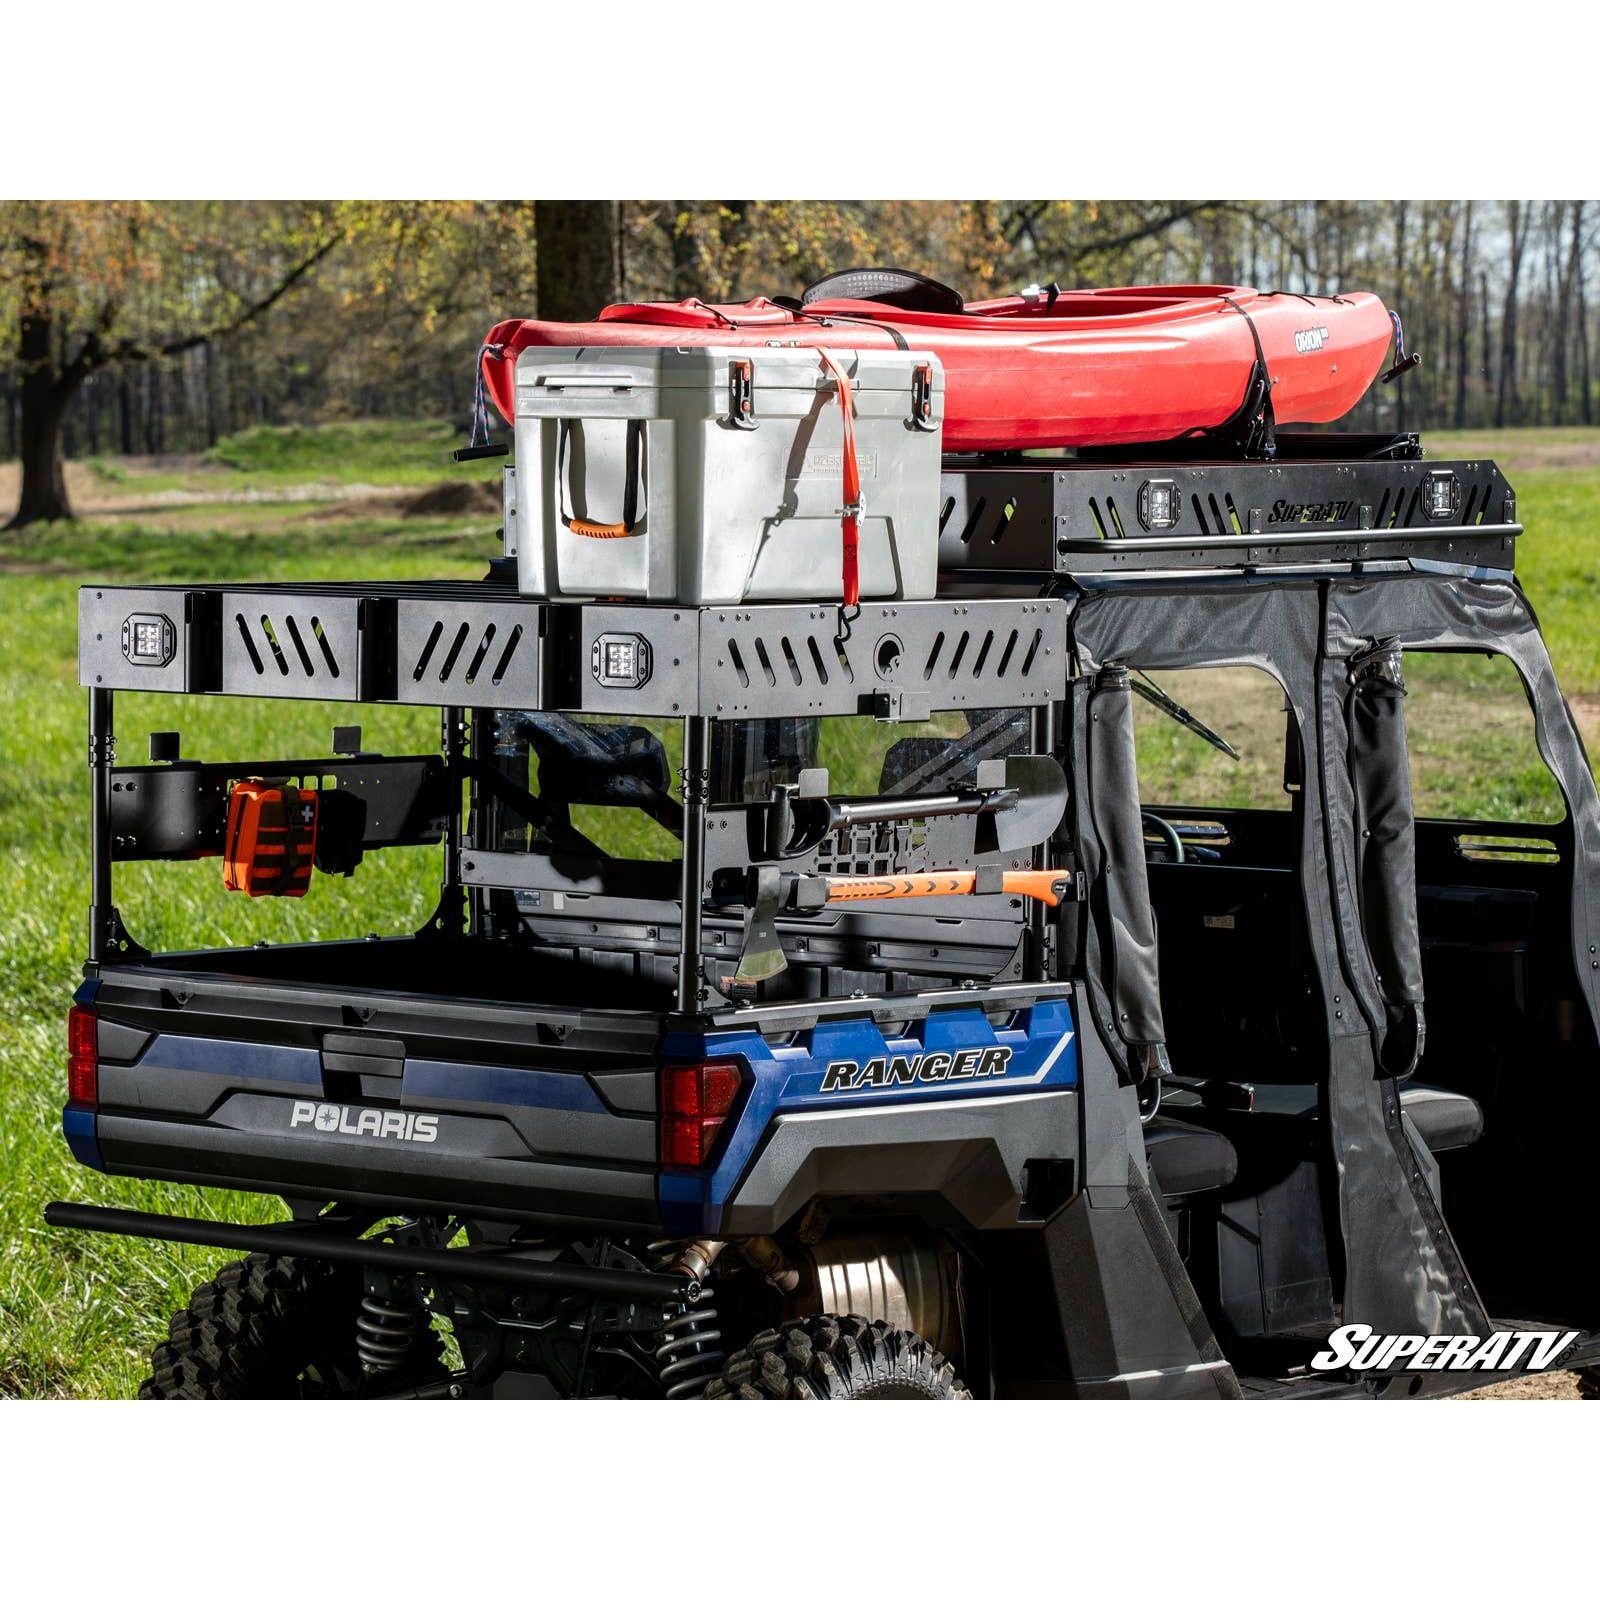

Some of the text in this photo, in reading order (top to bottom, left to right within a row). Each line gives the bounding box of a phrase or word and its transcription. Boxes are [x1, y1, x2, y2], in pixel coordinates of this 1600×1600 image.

[1267, 499, 1354, 523] SUPERATV
[820, 1046, 1012, 1092] RANGER
[290, 1101, 439, 1143] POLARIS
